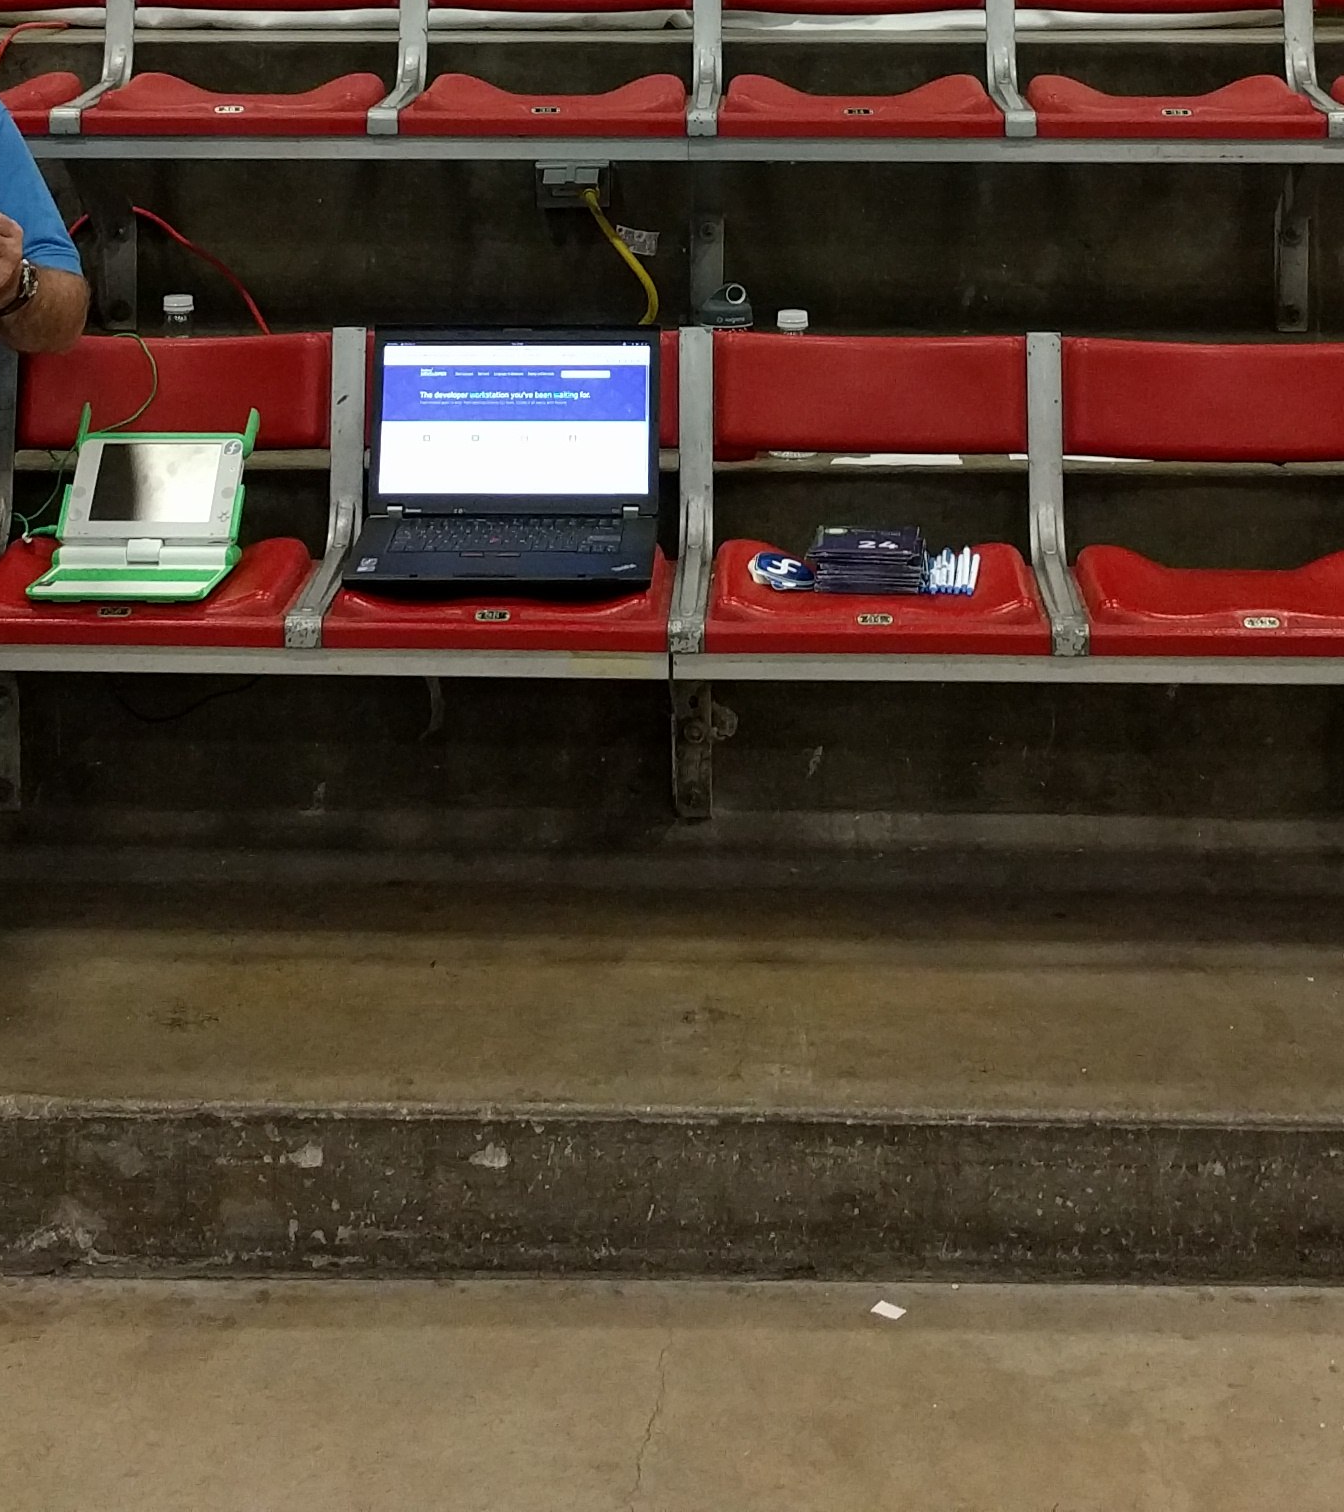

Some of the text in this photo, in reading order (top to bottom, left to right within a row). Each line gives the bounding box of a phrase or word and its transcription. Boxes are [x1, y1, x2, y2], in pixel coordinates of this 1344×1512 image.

[434, 391, 468, 399] developer
[510, 391, 533, 399] you've
[553, 391, 578, 400] waiting
